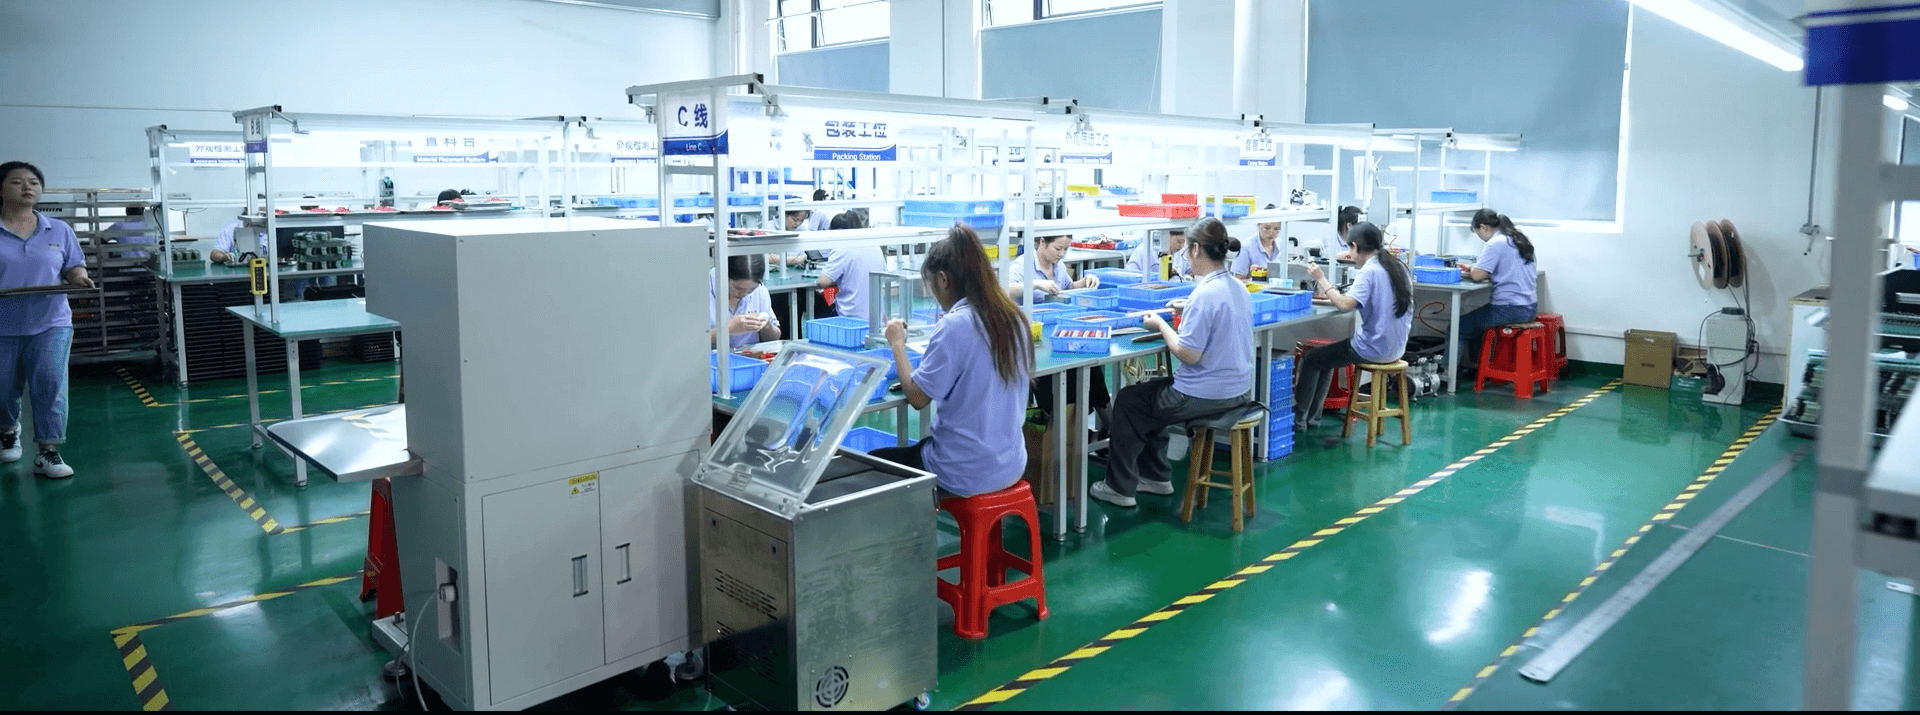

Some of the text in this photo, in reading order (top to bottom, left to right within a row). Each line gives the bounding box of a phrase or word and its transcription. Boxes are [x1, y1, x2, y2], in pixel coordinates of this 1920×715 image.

[678, 103, 708, 128] C 线
[825, 120, 887, 138] 包装工位
[686, 142, 702, 151] Line C
[832, 152, 881, 160] Packing Station
